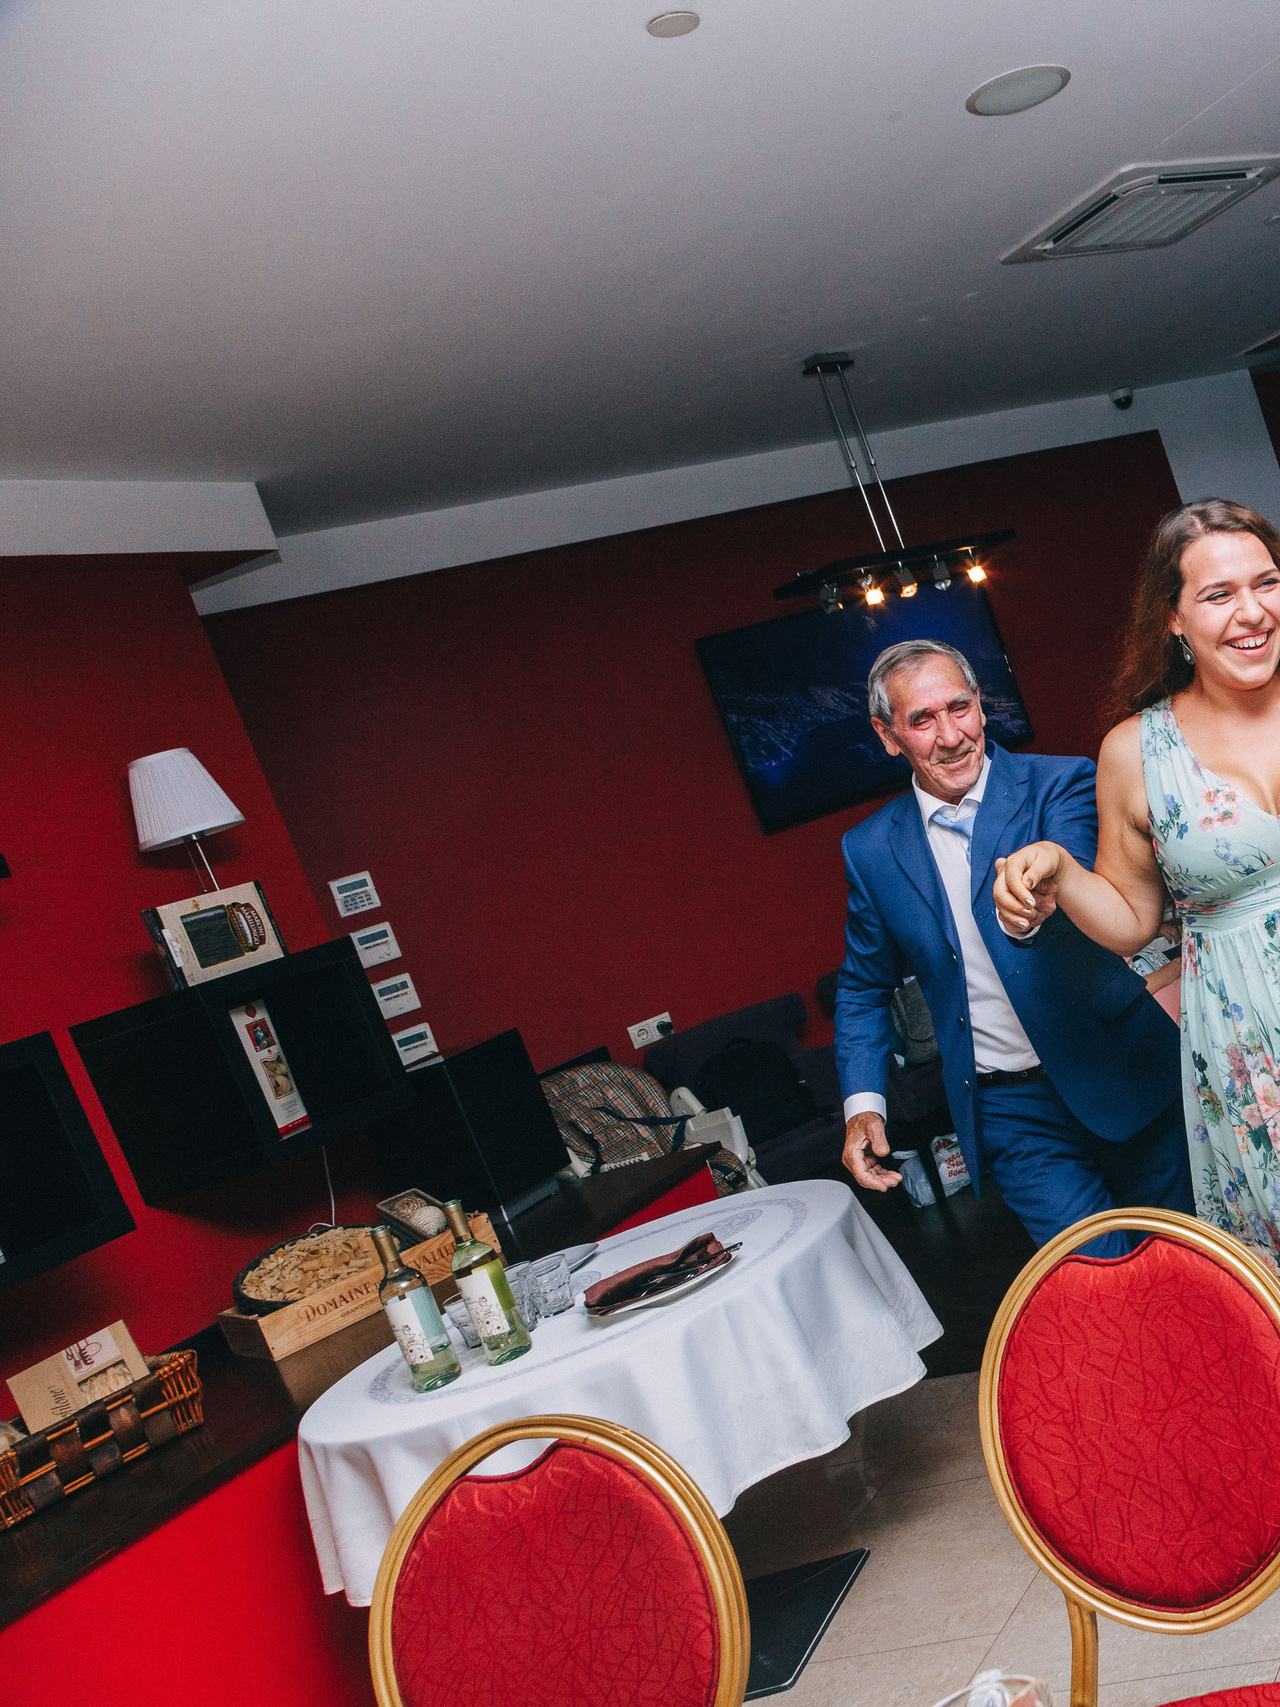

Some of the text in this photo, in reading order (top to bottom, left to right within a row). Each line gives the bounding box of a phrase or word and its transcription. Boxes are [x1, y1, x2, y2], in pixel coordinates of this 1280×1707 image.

[240, 906, 260, 945] MARILUNGO
[250, 910, 265, 937] MARONI
[298, 1282, 374, 1322] DOMAINE
[408, 1241, 457, 1270] VALIE
[340, 1303, 366, 1318] GRAND
